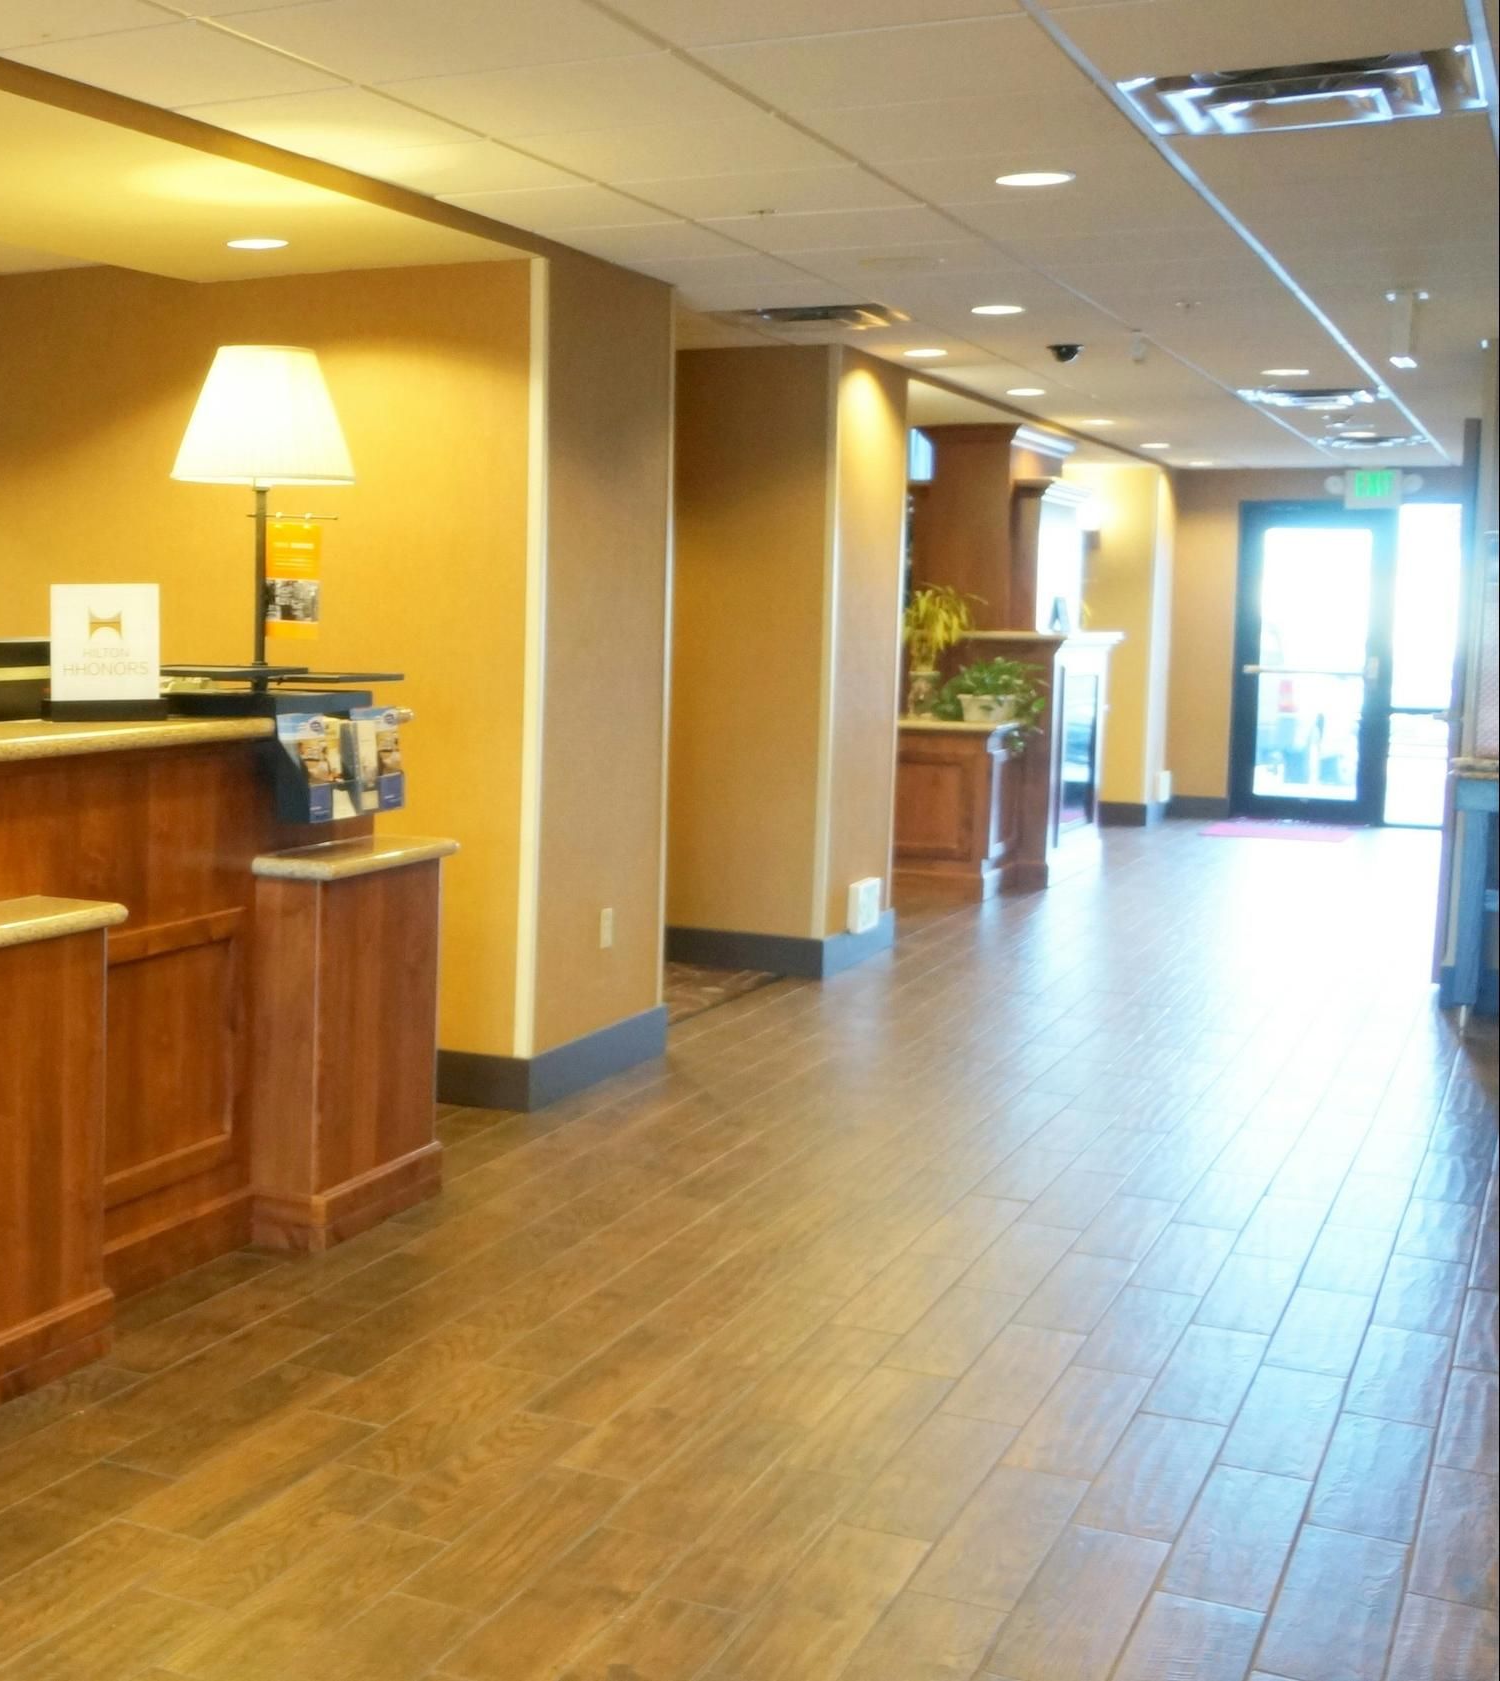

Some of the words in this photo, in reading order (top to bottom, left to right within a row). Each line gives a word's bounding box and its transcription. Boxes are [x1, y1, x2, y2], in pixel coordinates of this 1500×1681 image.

[1355, 470, 1395, 497] EXIT
[82, 647, 131, 658] HILTON
[62, 661, 149, 676] HHONORS
